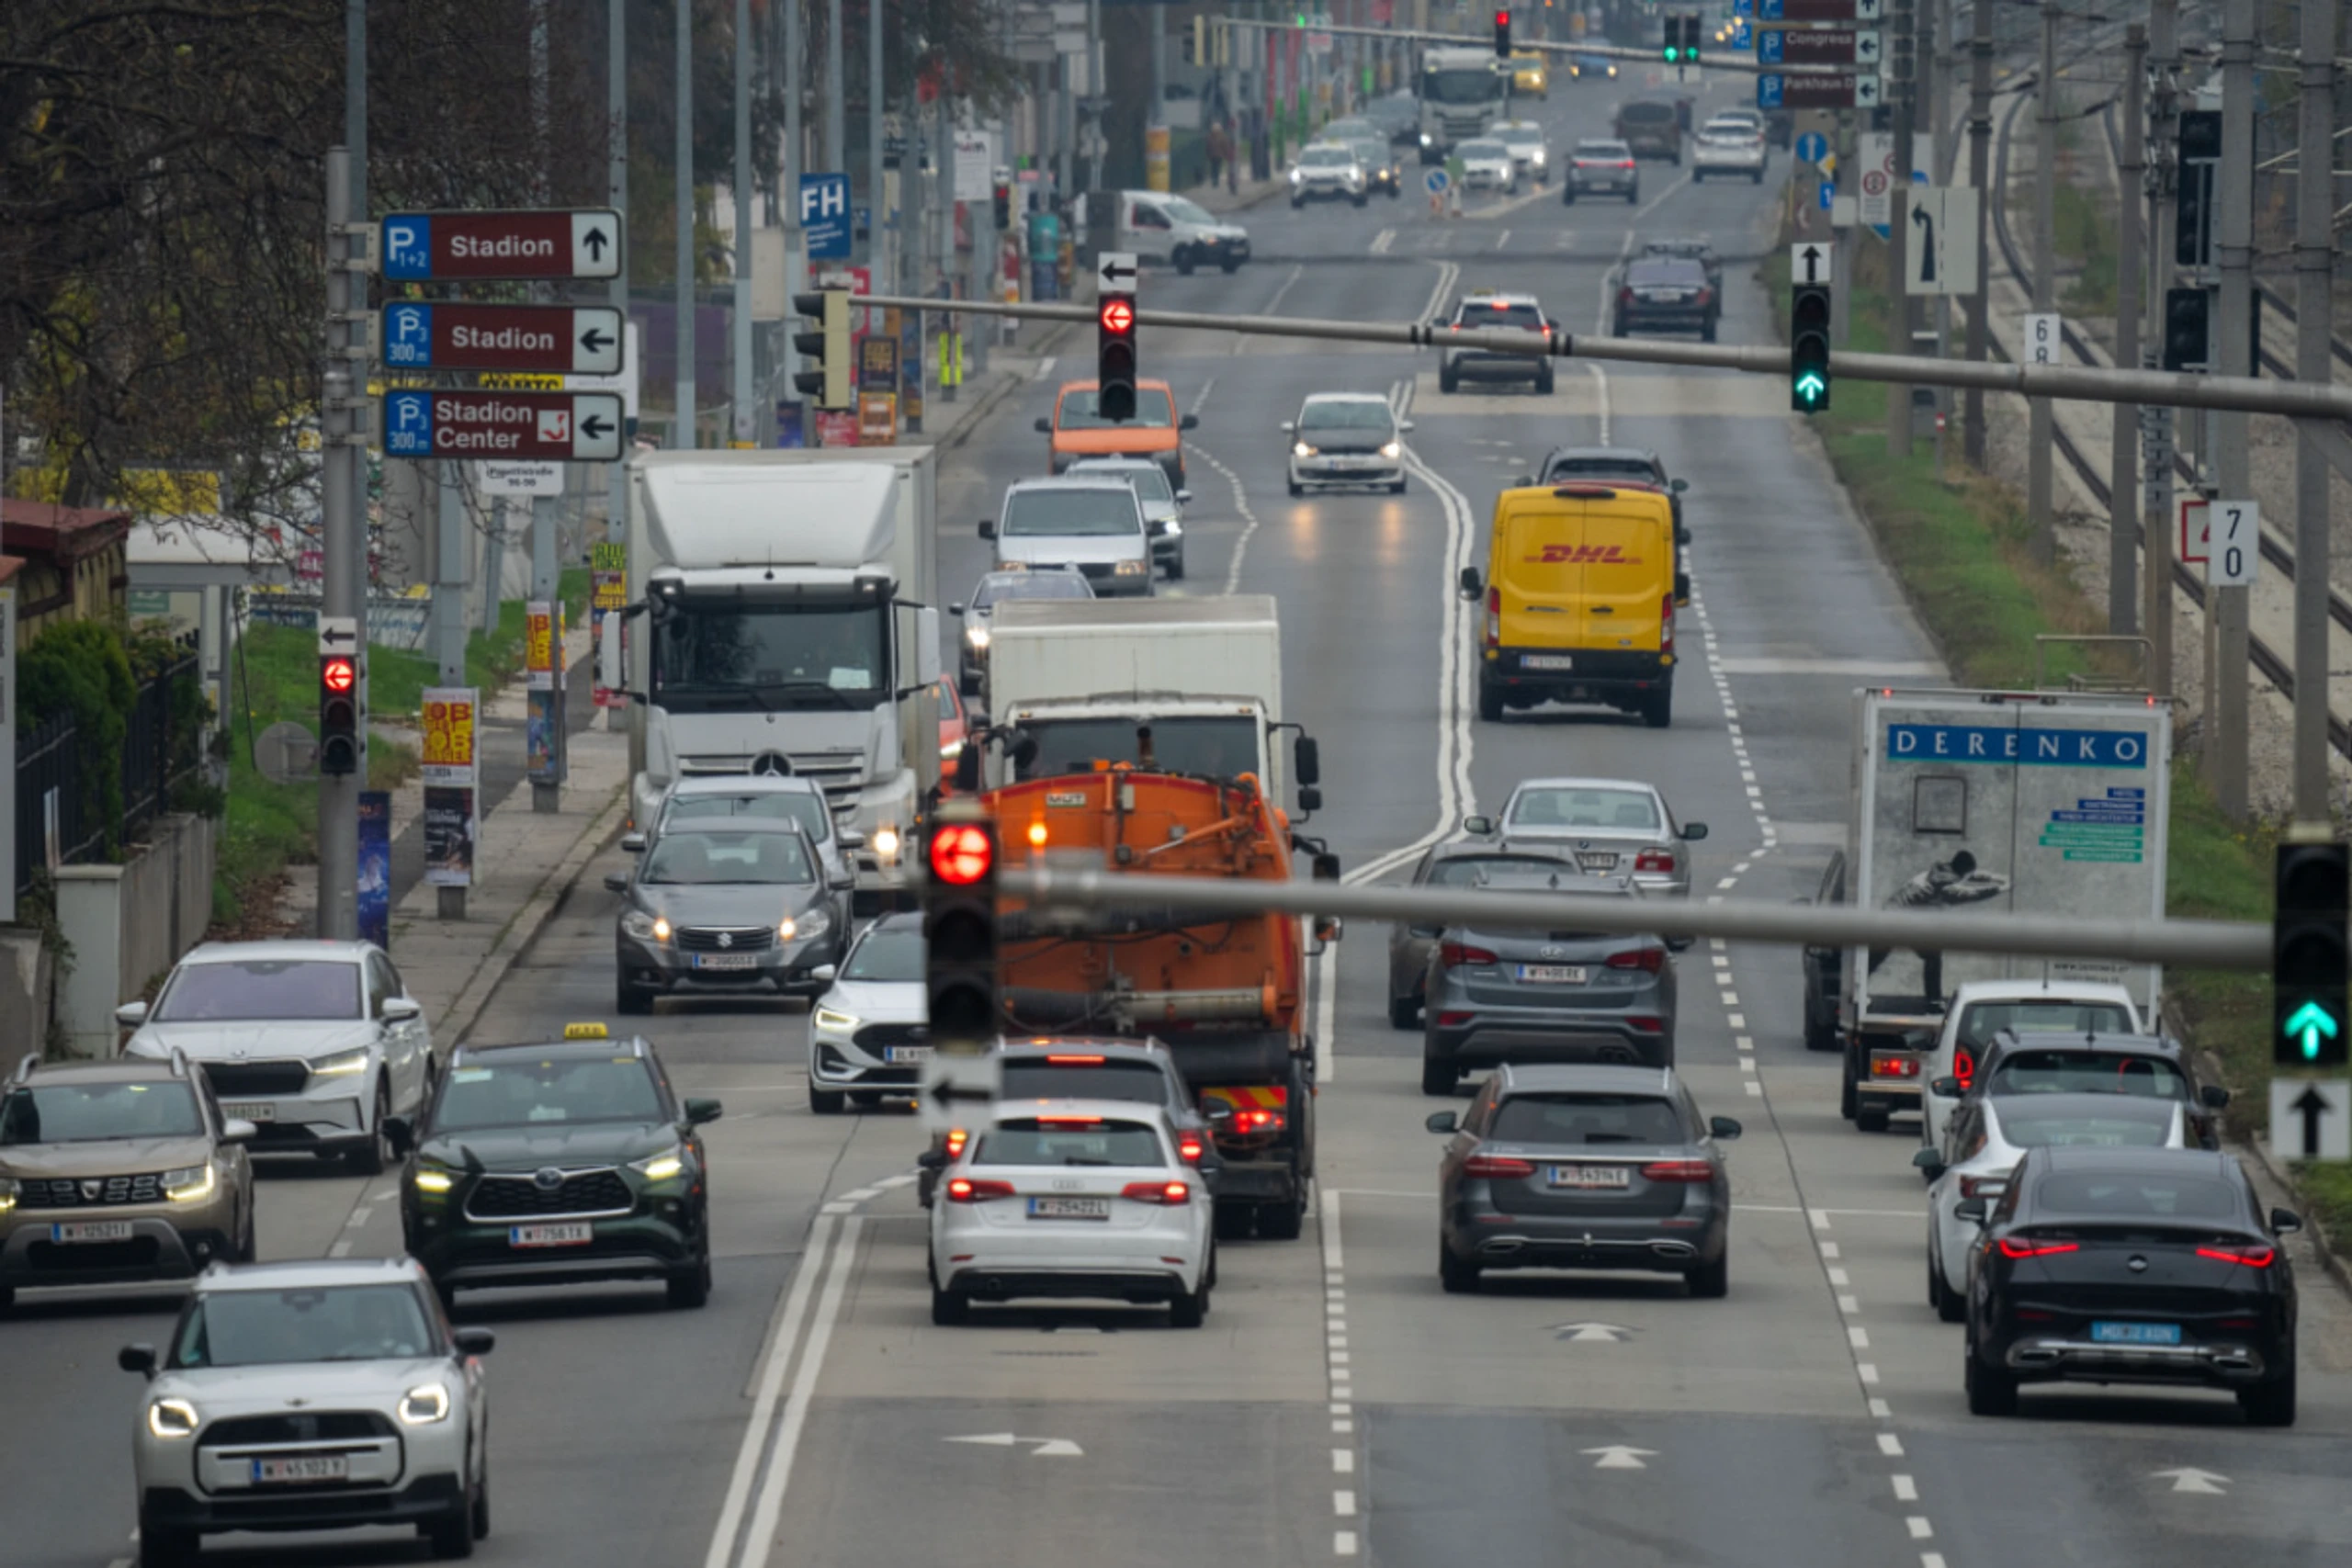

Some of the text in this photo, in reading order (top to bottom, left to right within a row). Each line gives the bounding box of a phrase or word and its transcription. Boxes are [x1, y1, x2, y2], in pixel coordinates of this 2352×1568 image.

[1786, 32, 1853, 48] Congress
[1784, 77, 1842, 90] Parkhaus
[1845, 77, 1856, 89] D
[801, 184, 844, 221] FH
[389, 227, 554, 262] P Stadion
[451, 325, 555, 350] Stadion
[389, 344, 415, 362] 300
[435, 400, 532, 423] Stadion
[389, 432, 415, 450] 300
[435, 426, 521, 449] Center
[1540, 544, 1626, 563] DHL
[1896, 730, 2140, 761] DERENKO
